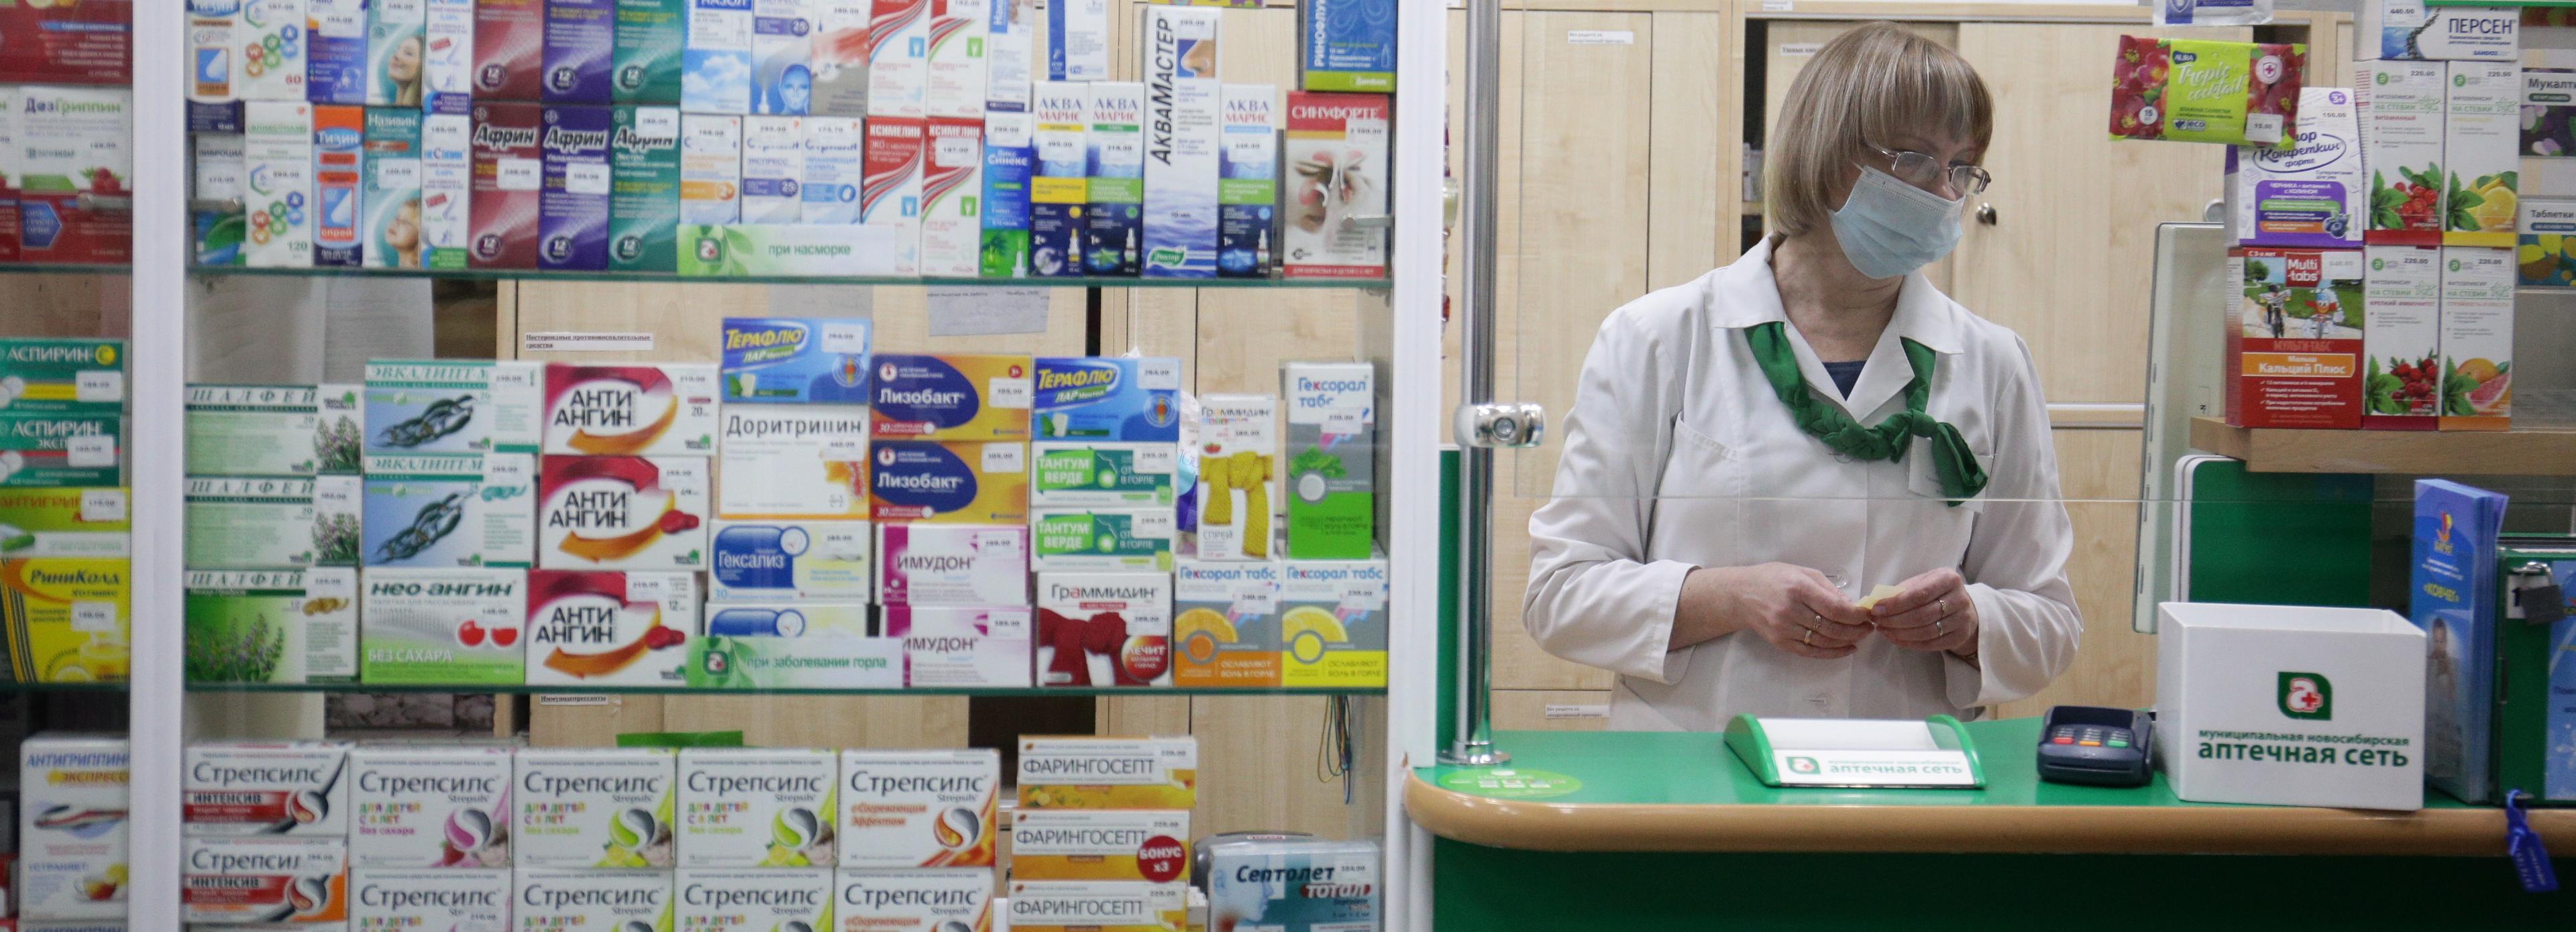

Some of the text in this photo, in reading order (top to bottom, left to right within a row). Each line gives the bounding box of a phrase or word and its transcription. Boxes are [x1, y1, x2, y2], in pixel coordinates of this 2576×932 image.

[2449, 18, 2512, 34] ПЕРСЕН
[2176, 62, 2232, 88] Tropic
[2189, 74, 2249, 101] cocktail
[2528, 78, 2576, 91] Мукалт
[1040, 98, 1082, 111] АКВА
[1094, 98, 1138, 111] АКВА
[1226, 100, 1269, 112] АКВА
[1037, 111, 1079, 122] МАРИС
[1093, 111, 1136, 122] МАРИС
[1224, 114, 1269, 125] МАРИС
[1291, 105, 1380, 121] СИНУФОРТЕ
[318, 132, 359, 145] Тизин
[474, 125, 536, 147] Африн
[545, 129, 605, 150] Африн
[2259, 143, 2341, 162] Конфеткин
[2285, 158, 2316, 168] форте
[2531, 209, 2575, 219] Таблетки
[768, 245, 851, 257] при насморке
[2287, 259, 2318, 270] Multi
[2259, 363, 2346, 375] Кальций Плюс
[1298, 377, 1366, 392] Гексорал
[570, 390, 633, 408] АНТИ
[879, 388, 961, 405] Лизобакт
[555, 409, 632, 426] АНГИН
[11, 420, 101, 436] АСПИРИН
[1038, 457, 1091, 469] ТАНТУМ
[877, 472, 958, 489] Лизобакт
[1044, 472, 1083, 485] ВЕРДЕ
[564, 491, 627, 510] АНТИ
[549, 510, 626, 528] АНГИН
[1038, 522, 1089, 534] ТАНТУМ
[1044, 537, 1083, 549] ВЕРДЕ
[718, 550, 786, 569] Гексализ
[897, 556, 971, 572] ИМУДОН
[1179, 566, 1277, 581] Гексорал табс
[1287, 566, 1383, 581] Гексорал табс
[1052, 585, 1156, 600] Граммидин
[551, 606, 613, 624] АНТИ
[535, 626, 613, 643] АНГИН
[368, 650, 453, 663] БЕЗ САХАРА
[1128, 646, 1166, 656] ЛЕЧИТ
[747, 654, 888, 670] при заболевании горла
[2199, 729, 2410, 747] муниципальная новосибирская
[2199, 741, 2409, 768] аптечная сеть
[193, 762, 322, 785] Стрепсилс
[1024, 758, 1154, 774] ФАРИНГОСЕПТ
[1830, 764, 1963, 774] аптечная сеть
[359, 770, 495, 797] Стрепсилс
[525, 770, 659, 797] Стрепсилс
[688, 770, 822, 797] Стрепсилс
[851, 770, 984, 797] Стрепсилс
[191, 793, 262, 803] ИНТЕНСИВ
[1016, 829, 1148, 845] ФАРИНГОСЕПТ
[1139, 846, 1183, 860] БОНУС
[191, 878, 260, 888] ИНТЕНСИВ
[1236, 866, 1335, 884] Септолет
[360, 884, 496, 911] Стрепсилс
[524, 884, 659, 910] Стрепсилс
[684, 884, 820, 910] Стрепсилс
[845, 883, 978, 910] Стрепсилс
[1013, 900, 1144, 916] ФАРИНГОСЕПТ
